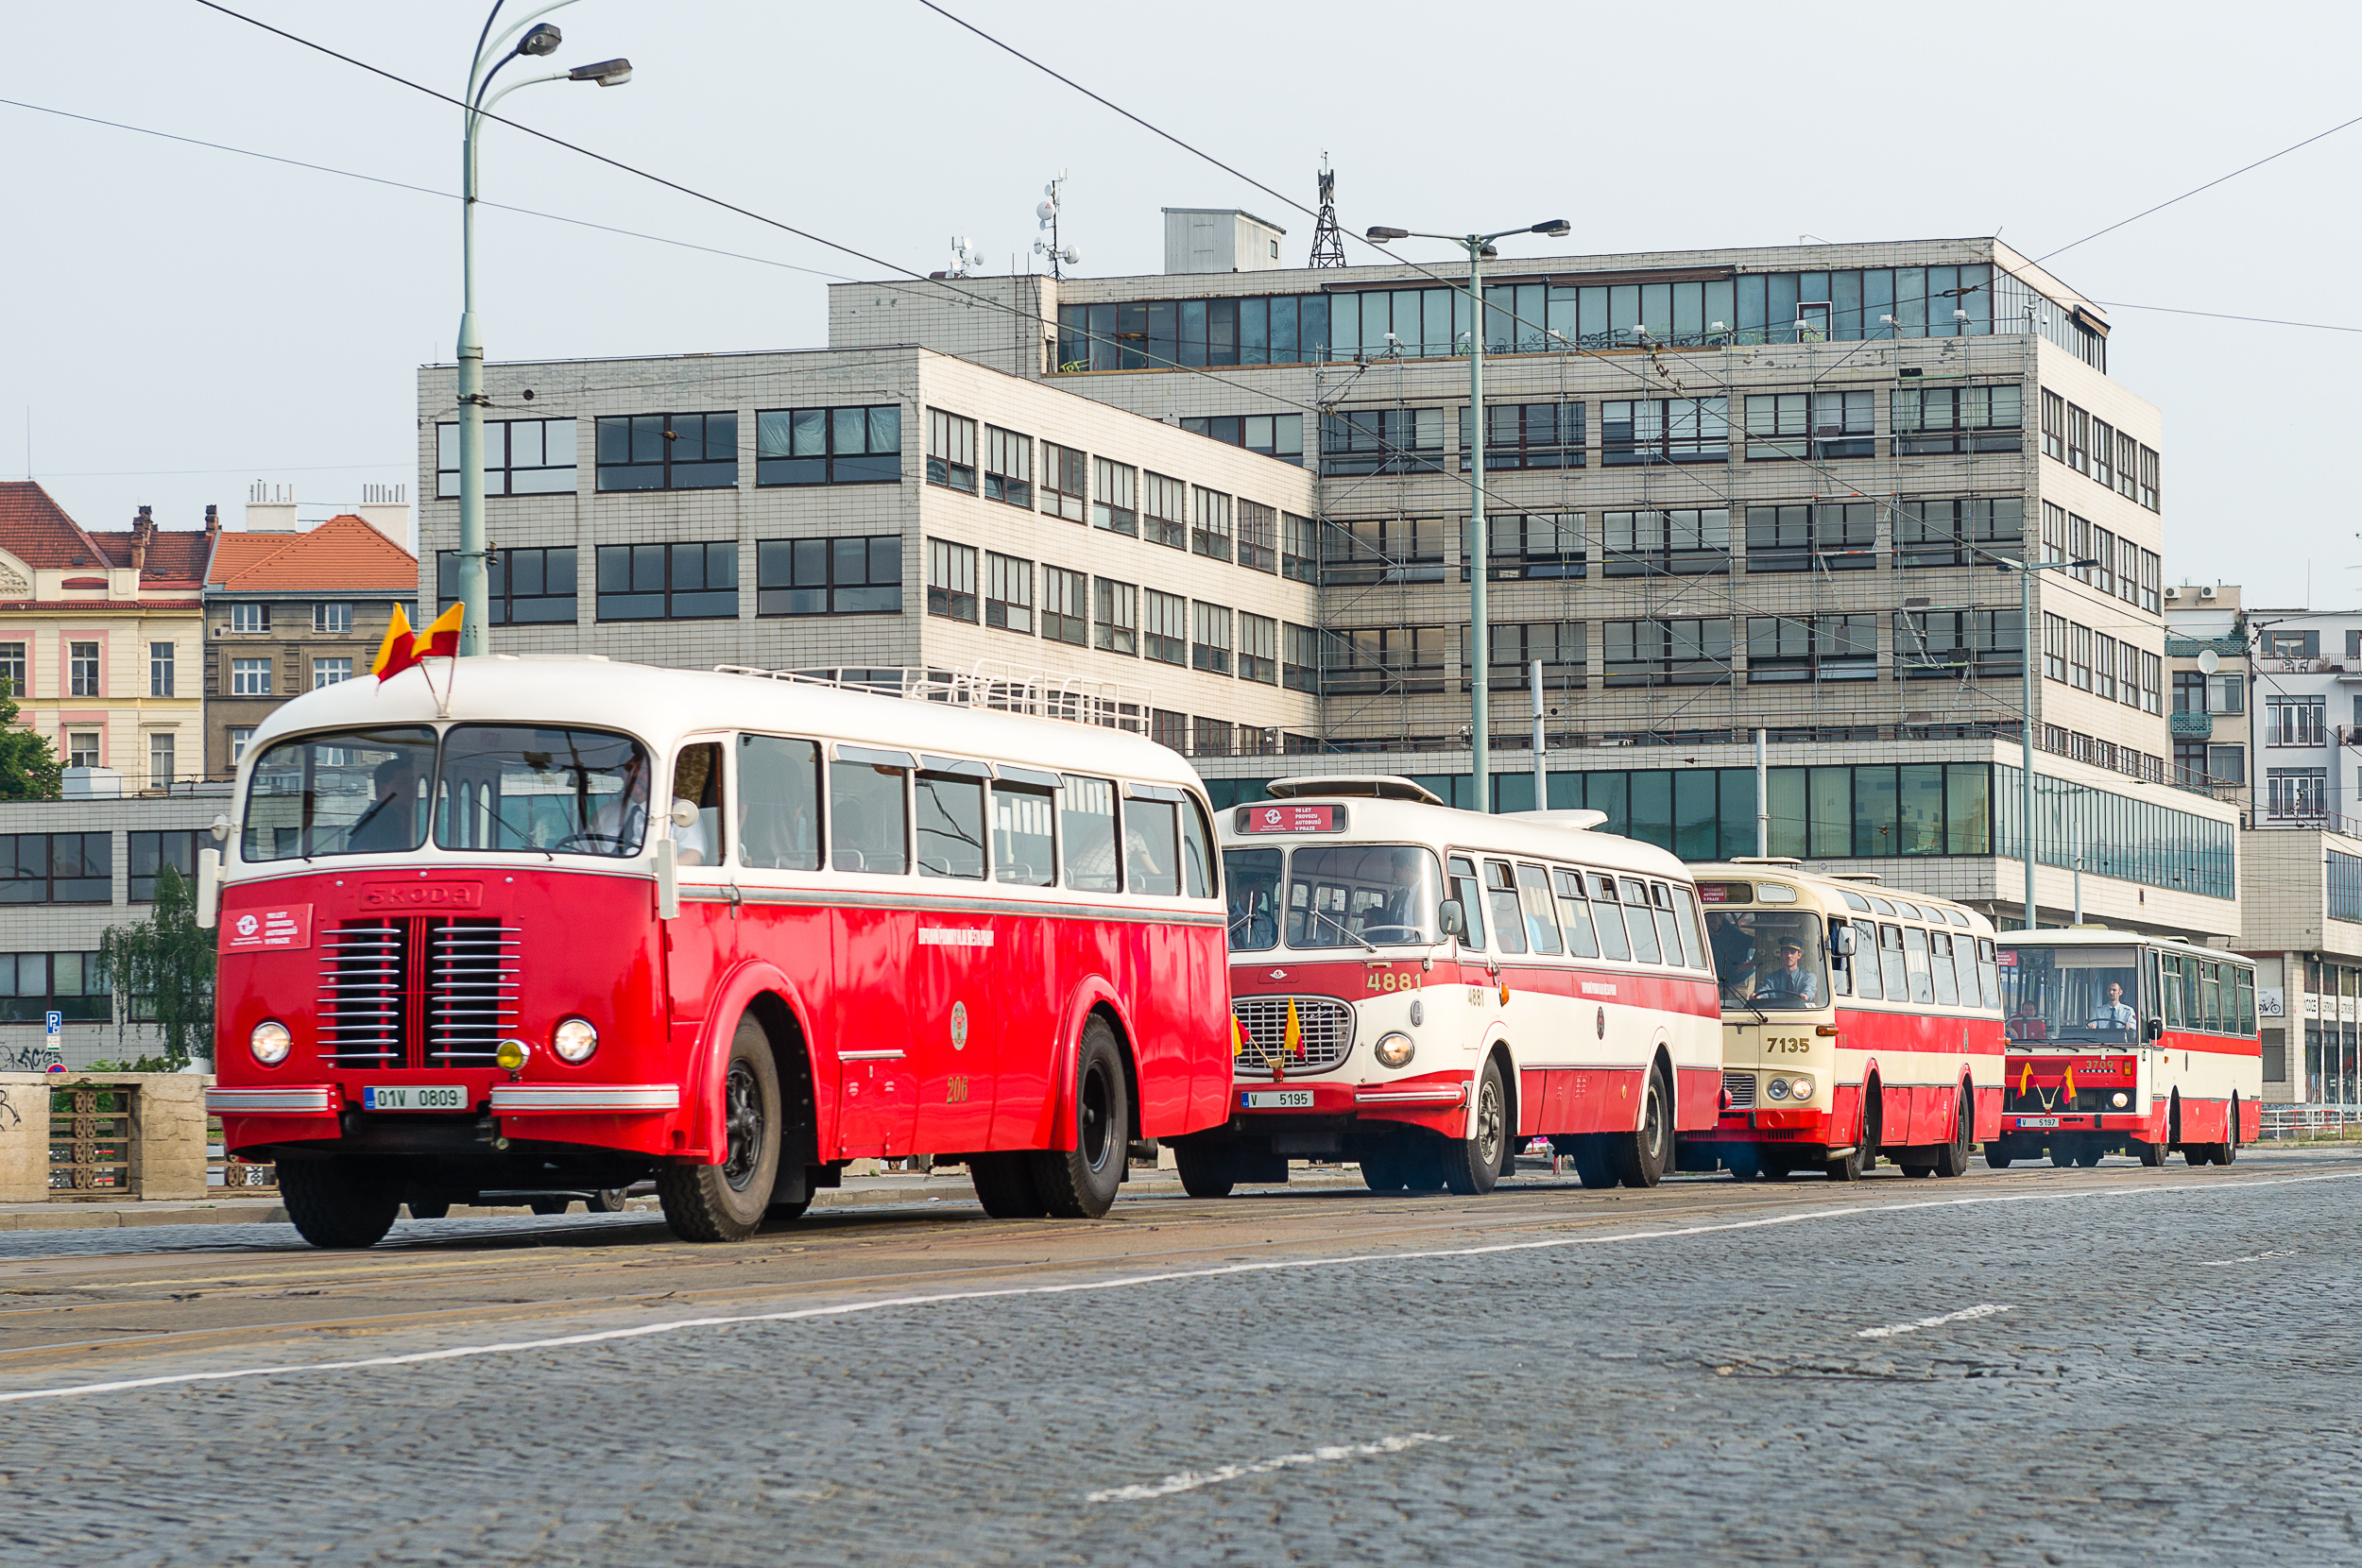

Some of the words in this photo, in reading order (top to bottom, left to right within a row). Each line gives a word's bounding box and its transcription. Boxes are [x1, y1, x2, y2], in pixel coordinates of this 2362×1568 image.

[1366, 972, 1421, 992] 4881
[1467, 987, 1484, 1007] 4881
[1767, 1038, 1809, 1053] 7135
[2086, 1060, 2114, 1069] 3709
[378, 1090, 406, 1106] 01V
[419, 1089, 457, 1106] 0809
[947, 1077, 968, 1103] 206
[1251, 1094, 1258, 1106] V
[1279, 1093, 1308, 1105] 5195
